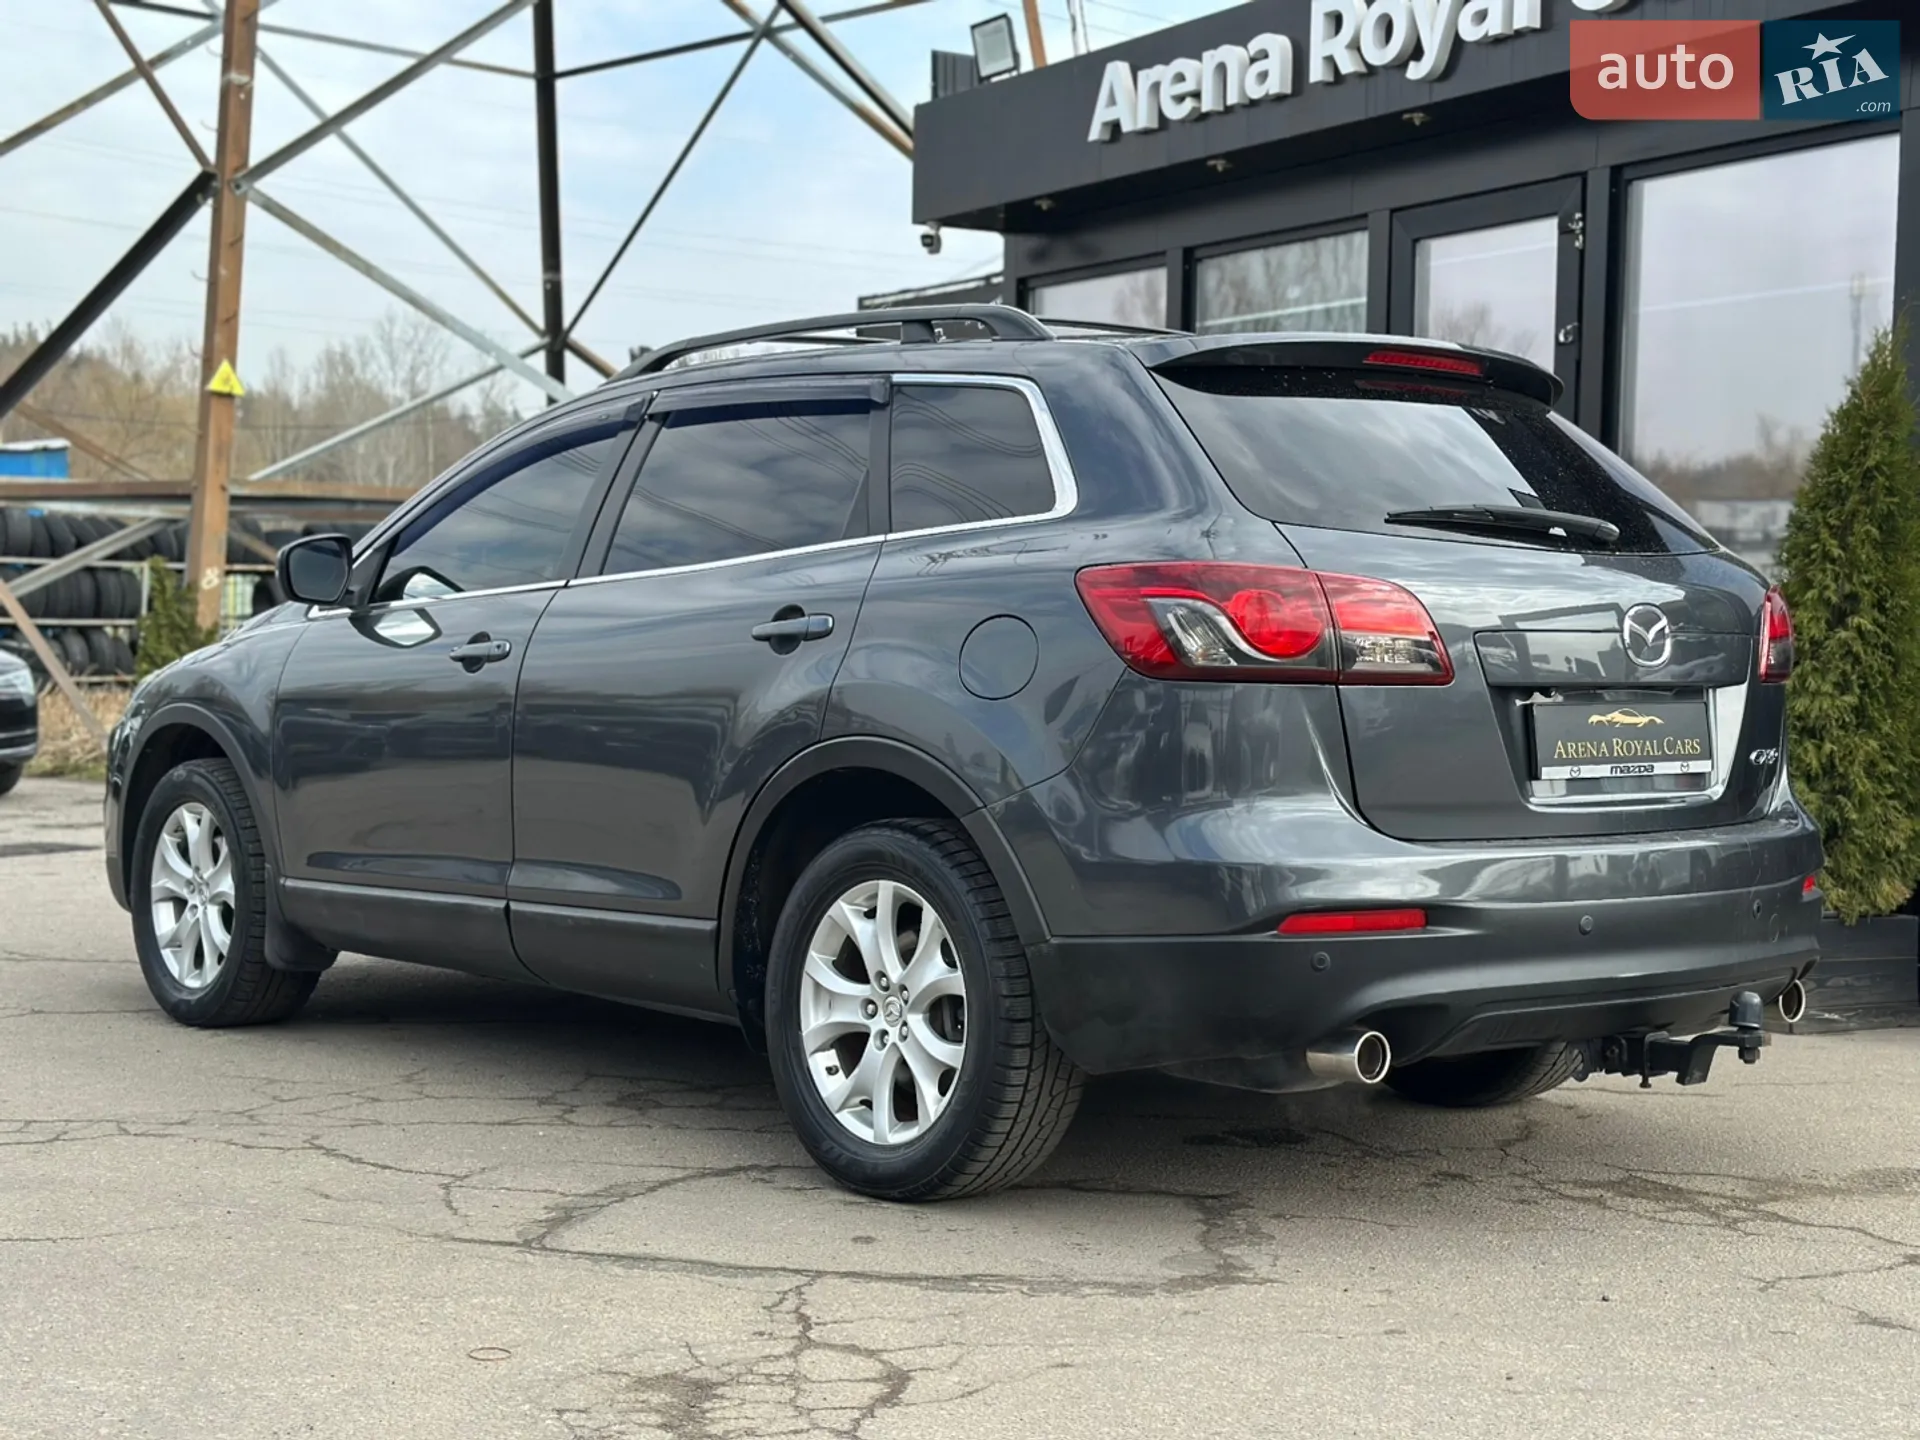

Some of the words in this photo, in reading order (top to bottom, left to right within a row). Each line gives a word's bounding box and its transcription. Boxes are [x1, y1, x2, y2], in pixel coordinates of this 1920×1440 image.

[1088, 32, 1293, 142] Arena
[1554, 740, 1609, 759] ARENA
[1612, 738, 1661, 757] ROYAL
[1664, 736, 1701, 755] CARS
